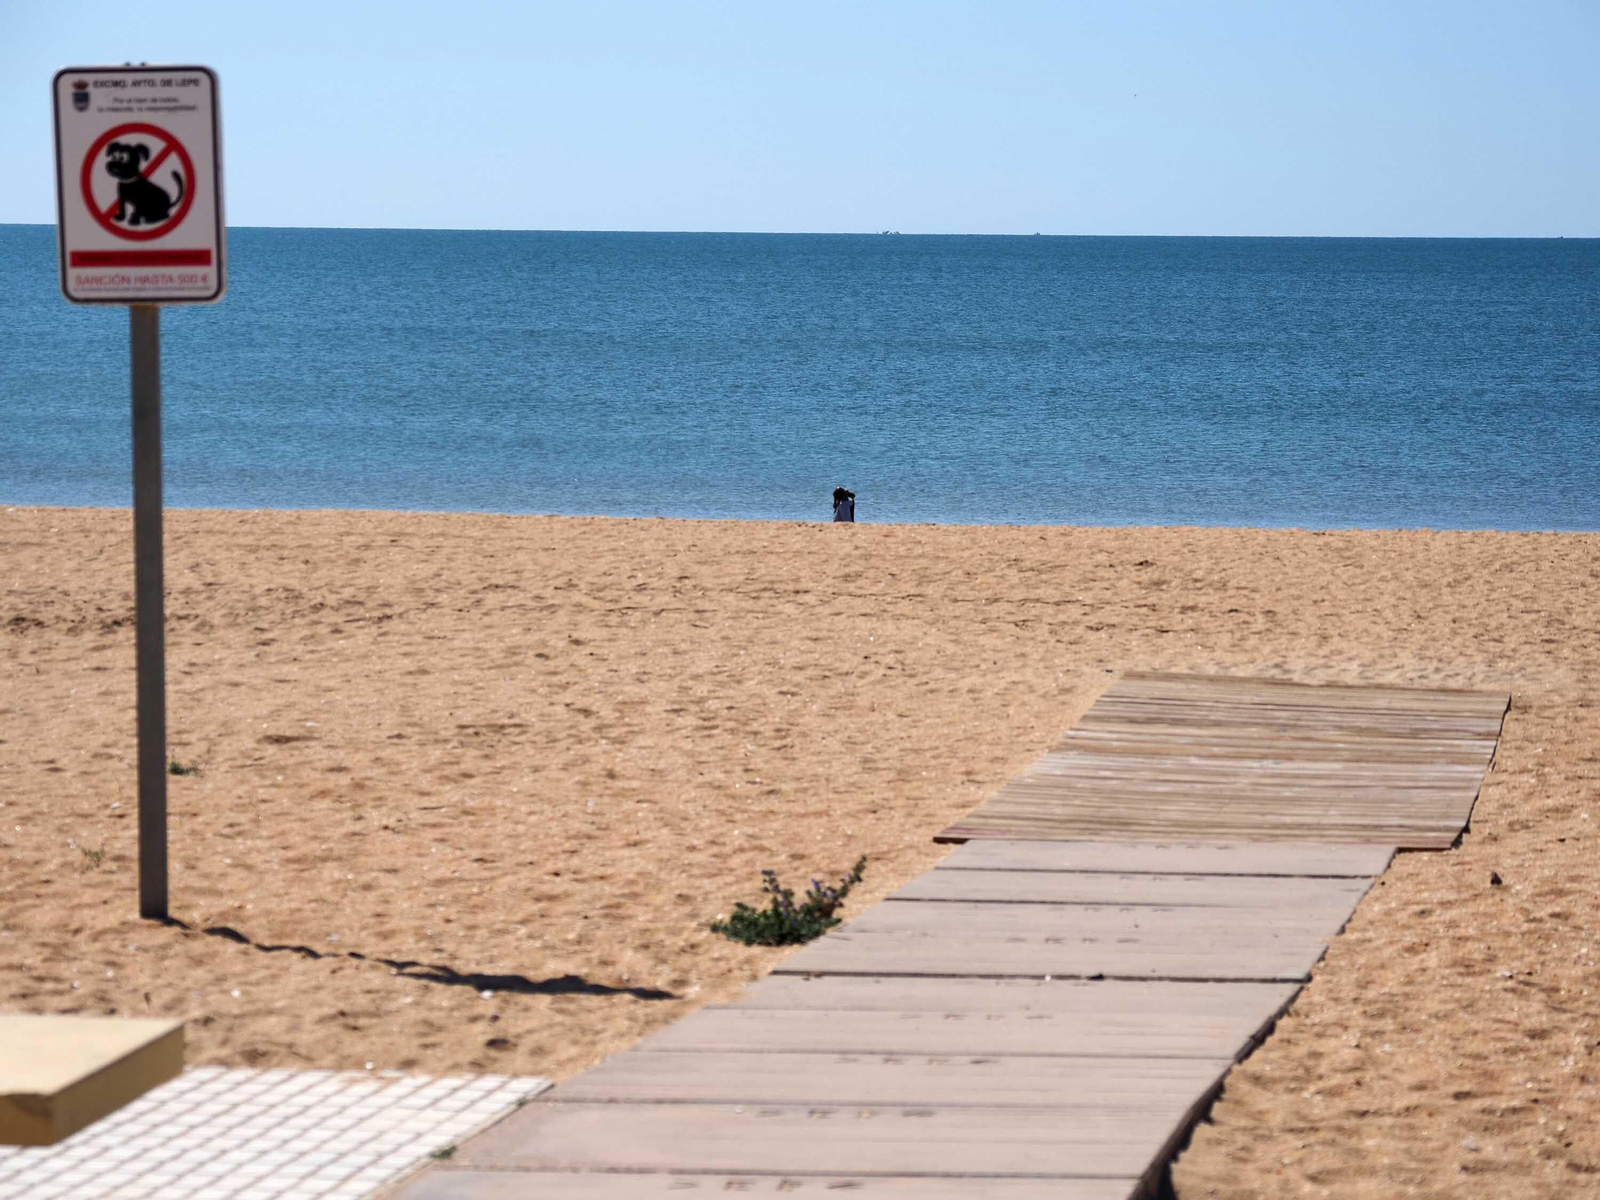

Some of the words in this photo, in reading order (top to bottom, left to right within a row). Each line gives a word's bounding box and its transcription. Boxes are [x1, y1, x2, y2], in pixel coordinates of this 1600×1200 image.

[160, 79, 172, 87] DE
[175, 78, 199, 87] LEPE
[134, 273, 174, 285] HASTA
[177, 273, 198, 284] 500
